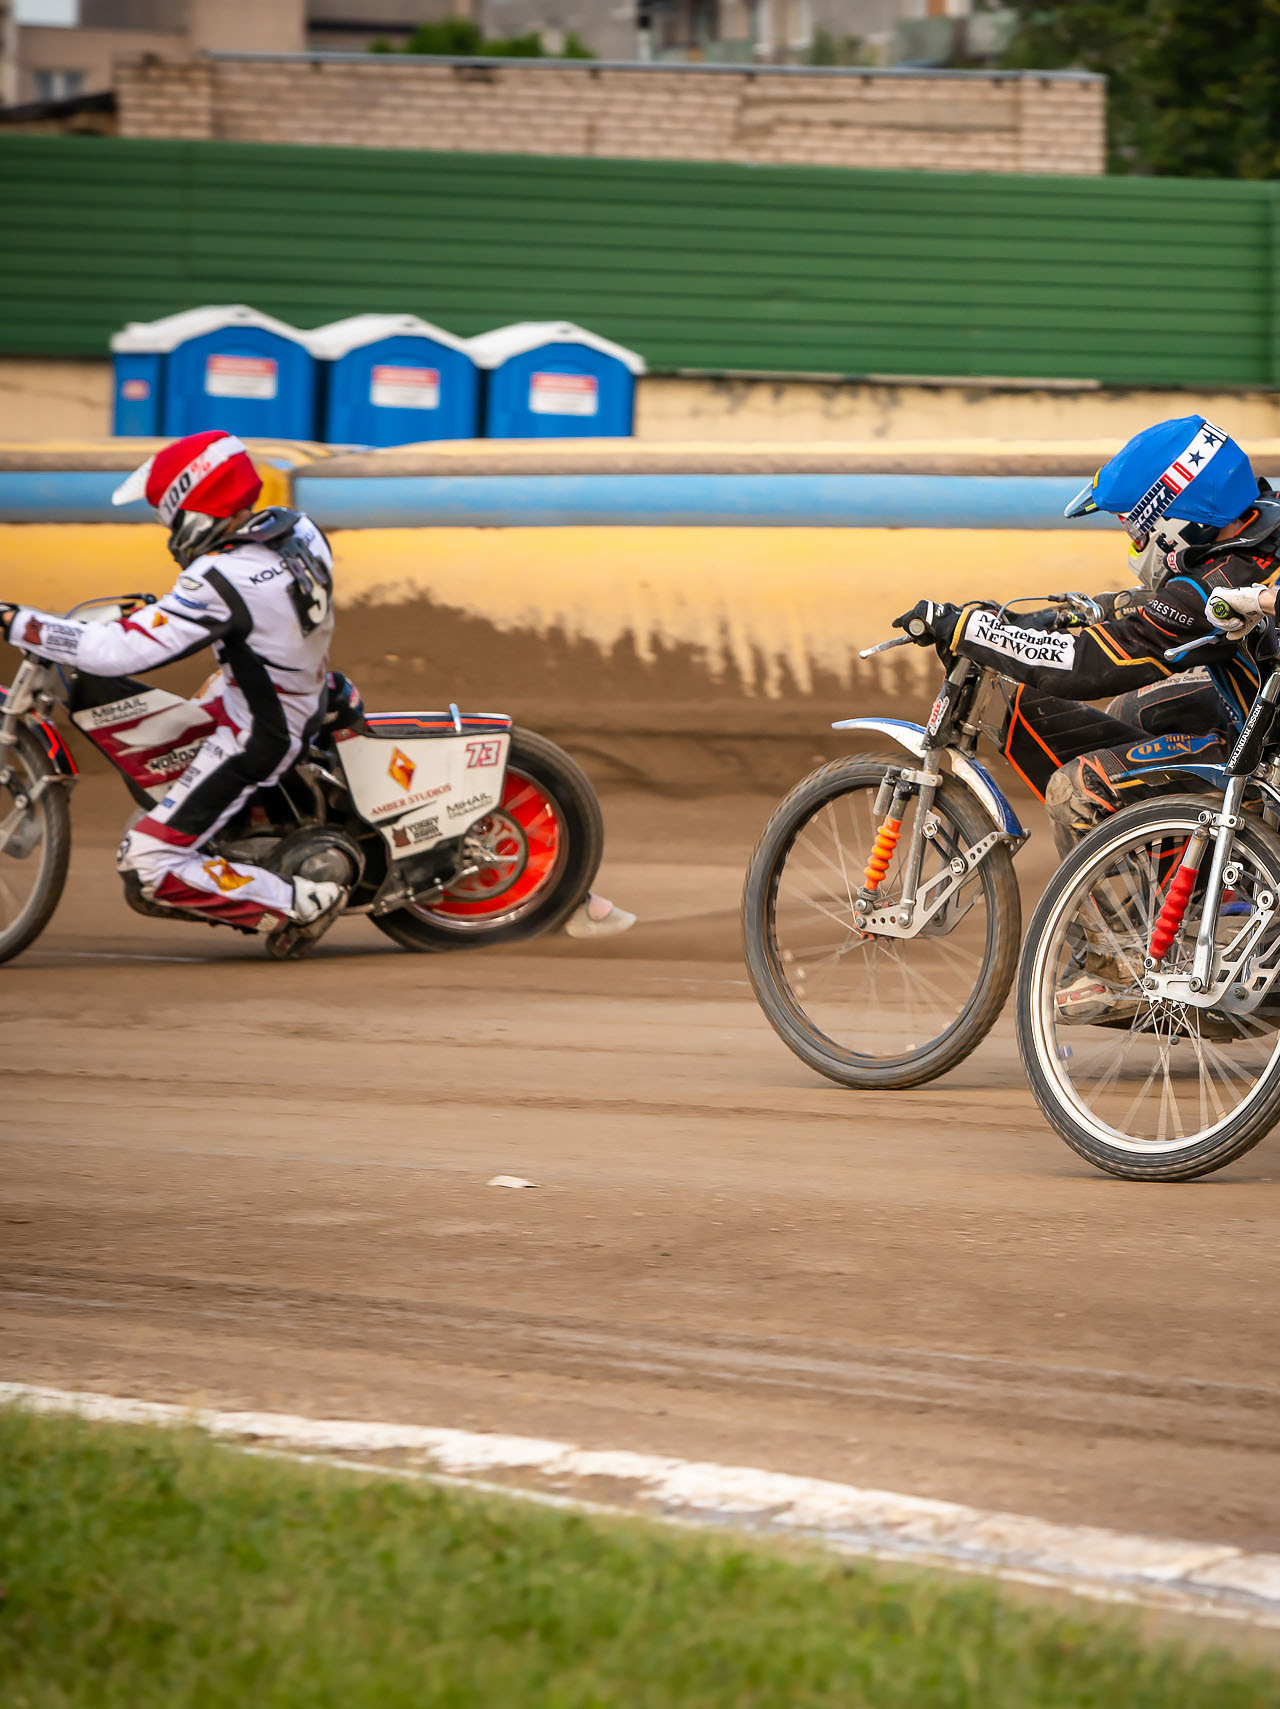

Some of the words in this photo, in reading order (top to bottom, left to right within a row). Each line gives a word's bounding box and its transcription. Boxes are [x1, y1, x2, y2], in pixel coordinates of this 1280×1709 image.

[164, 456, 211, 516] 100%
[1132, 486, 1167, 531] SCOTT
[249, 559, 288, 586] KOLO
[975, 626, 1064, 663] NETWORK
[466, 740, 502, 769] 73
[371, 799, 406, 817] AMBER
[408, 783, 453, 805] STUDIOS
